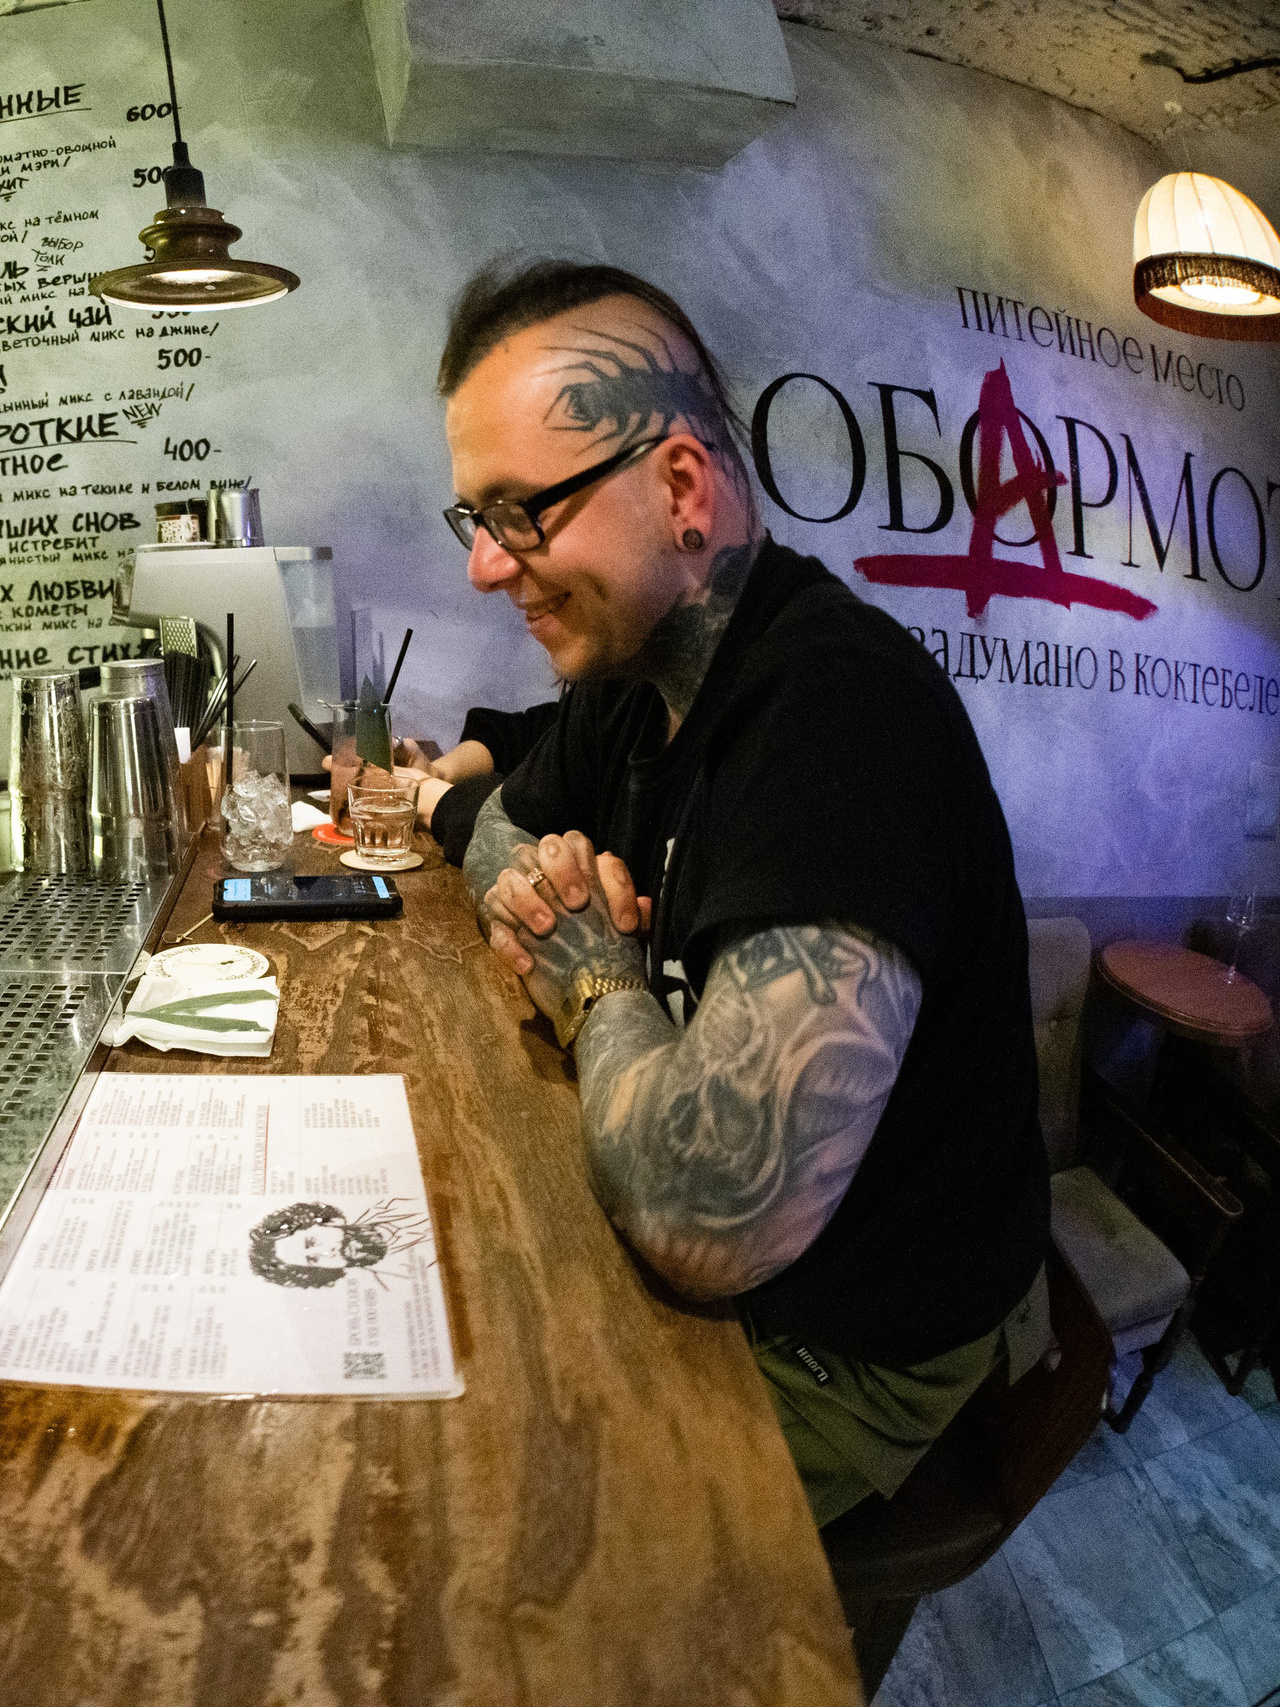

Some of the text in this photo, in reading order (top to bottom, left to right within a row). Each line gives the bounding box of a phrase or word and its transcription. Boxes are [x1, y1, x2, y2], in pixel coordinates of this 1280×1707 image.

[954, 285, 1246, 412] питейное место
[122, 403, 163, 420] NEW
